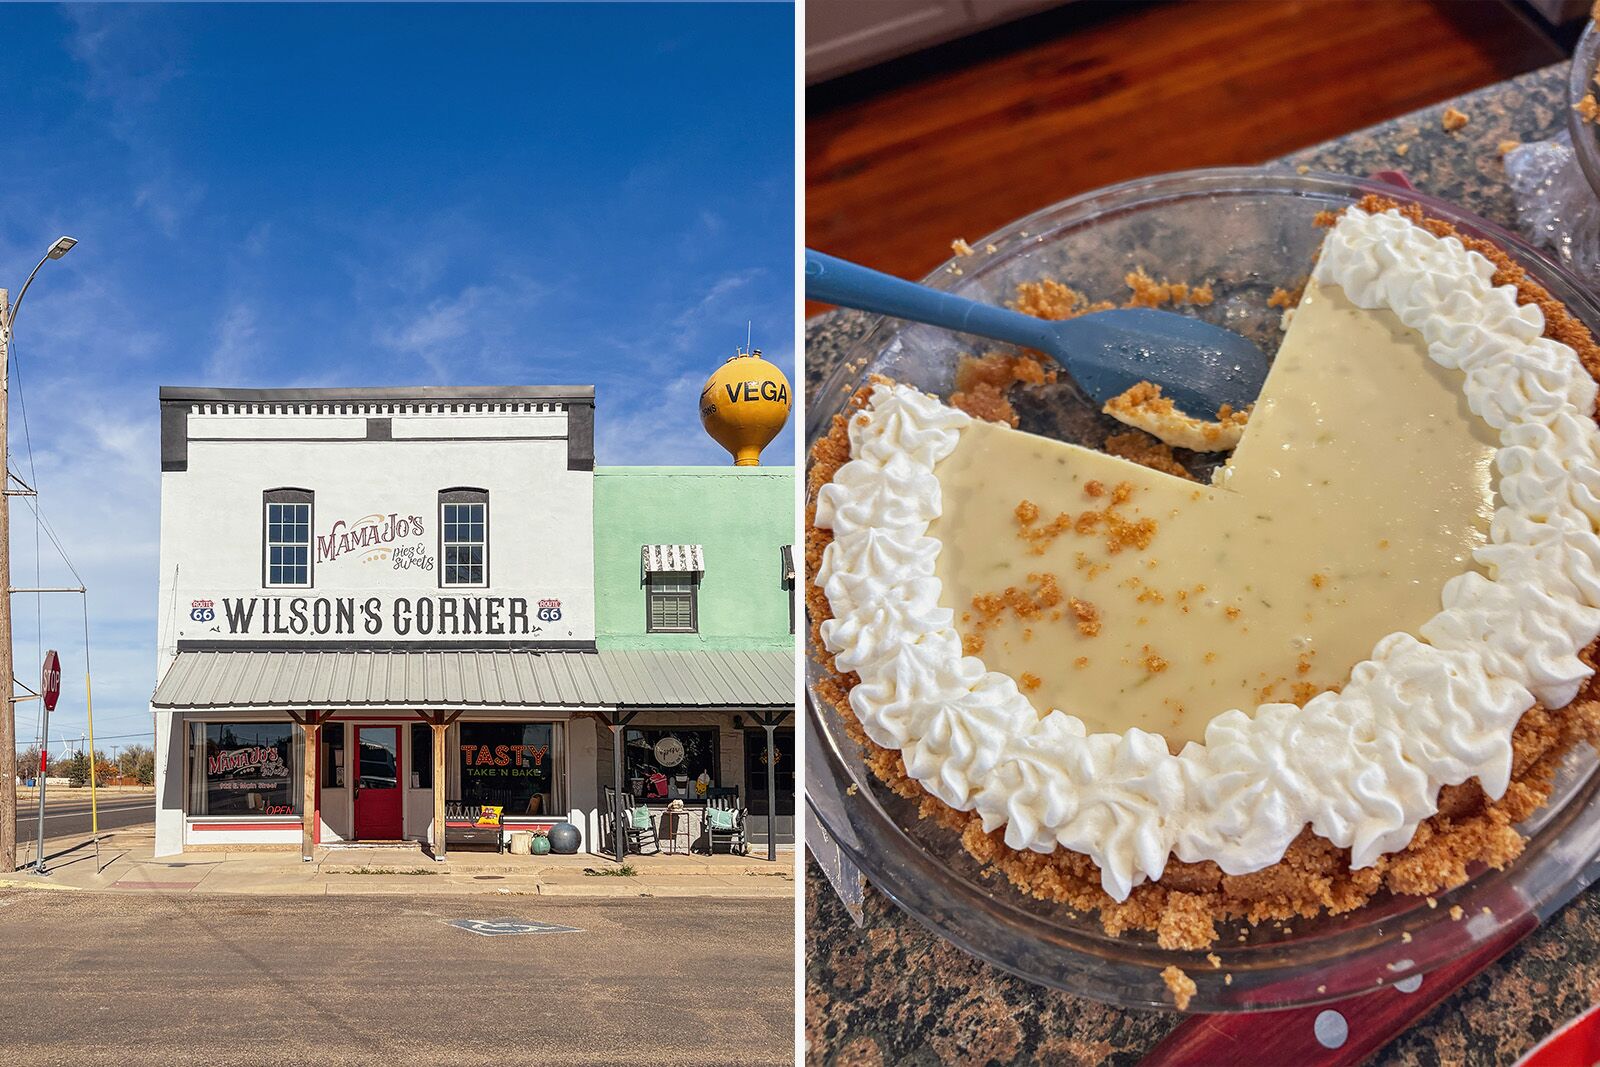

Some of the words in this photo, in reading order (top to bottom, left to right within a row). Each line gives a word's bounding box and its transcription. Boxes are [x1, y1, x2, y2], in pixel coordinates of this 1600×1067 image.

[726, 381, 787, 405] VEGA
[392, 544, 414, 561] pies
[416, 542, 425, 555] &
[393, 554, 434, 571] sweets
[193, 609, 212, 621] 66
[222, 597, 383, 635] WILSON'S
[393, 597, 530, 636] CORNER
[540, 609, 559, 620] 66
[43, 668, 60, 693] STOP
[460, 745, 549, 766] TASTY
[467, 768, 496, 777] TAKE
[512, 768, 541, 777] BAKE
[266, 806, 295, 815] OPEN
